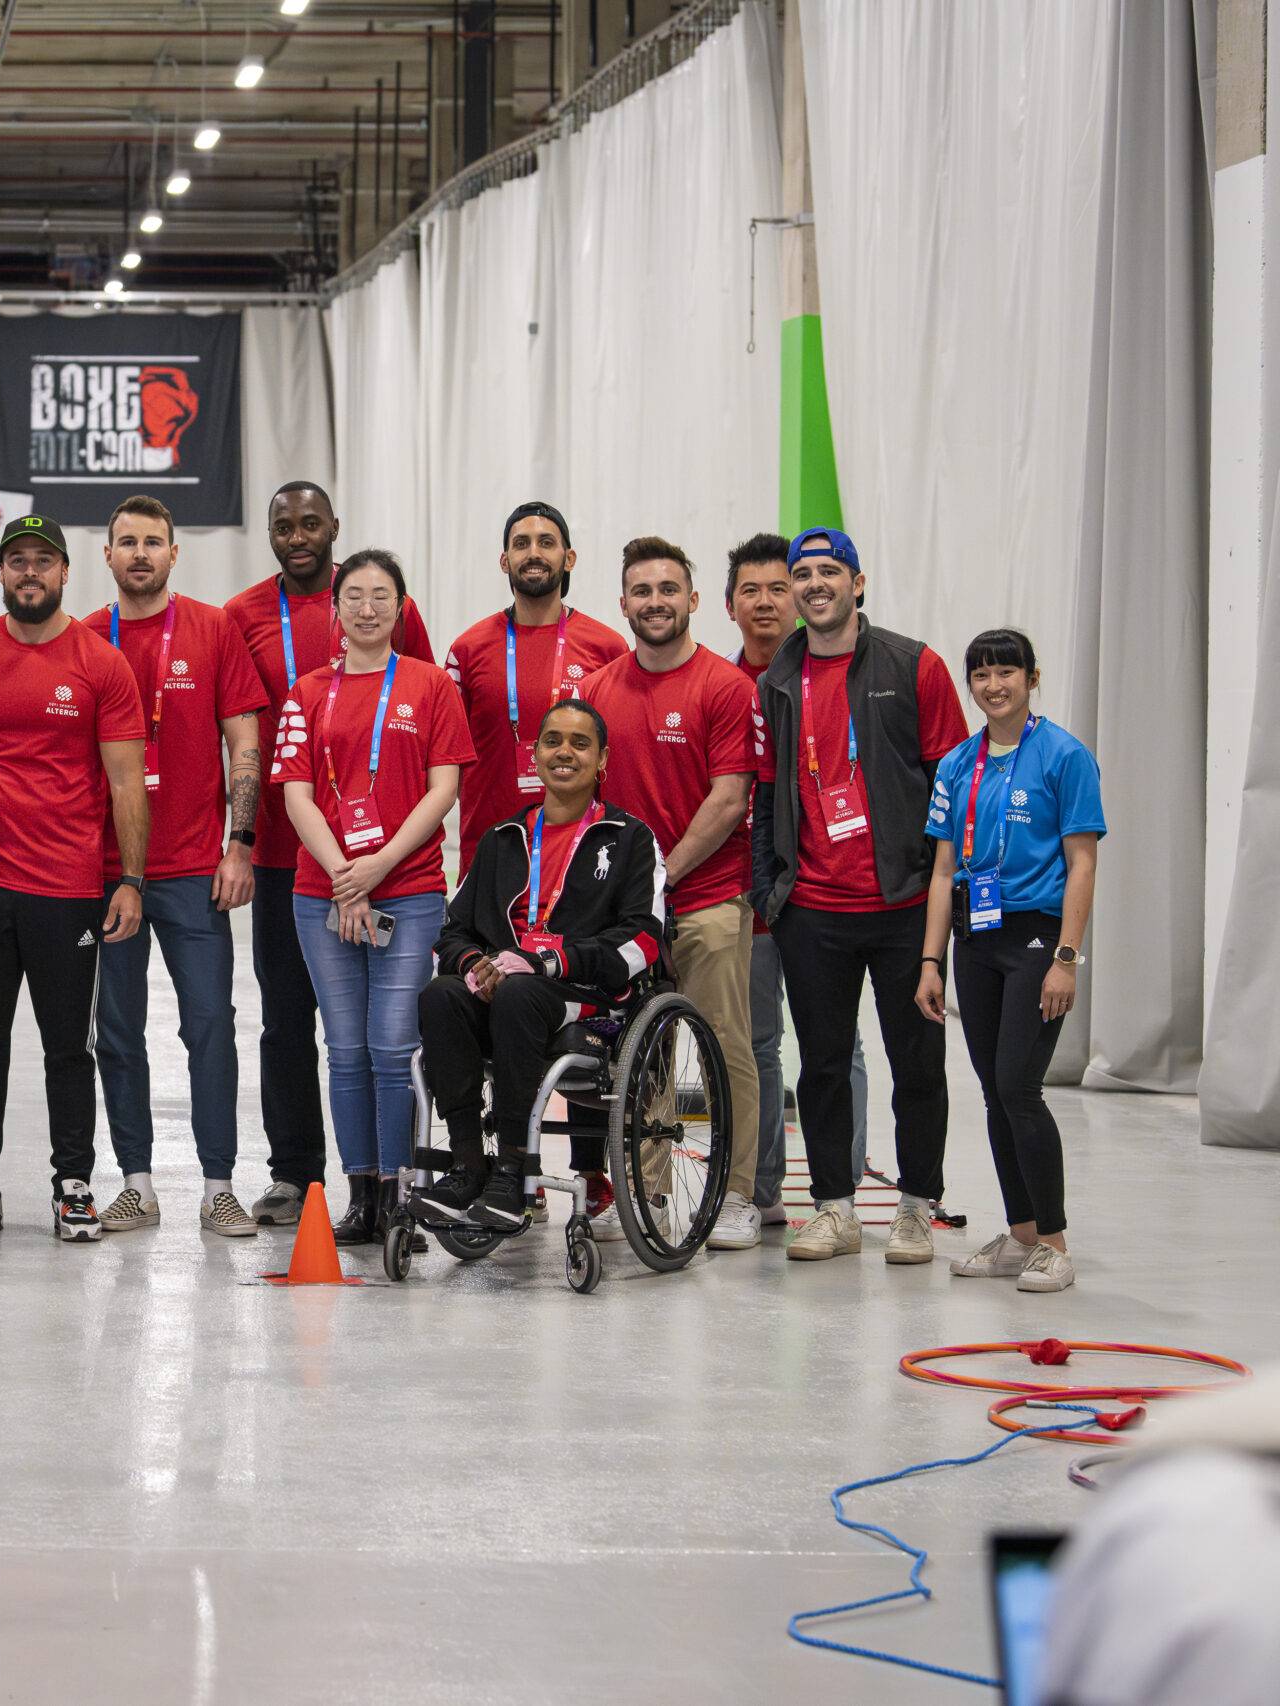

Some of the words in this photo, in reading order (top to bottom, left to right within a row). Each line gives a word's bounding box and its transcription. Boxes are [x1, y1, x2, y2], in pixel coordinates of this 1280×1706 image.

[31, 363, 141, 431] BOXE
[164, 682, 195, 690] ALTERGO
[45, 707, 79, 717] ALTERGO
[387, 722, 418, 734] ALTERGO
[656, 734, 687, 744] ALTERGO
